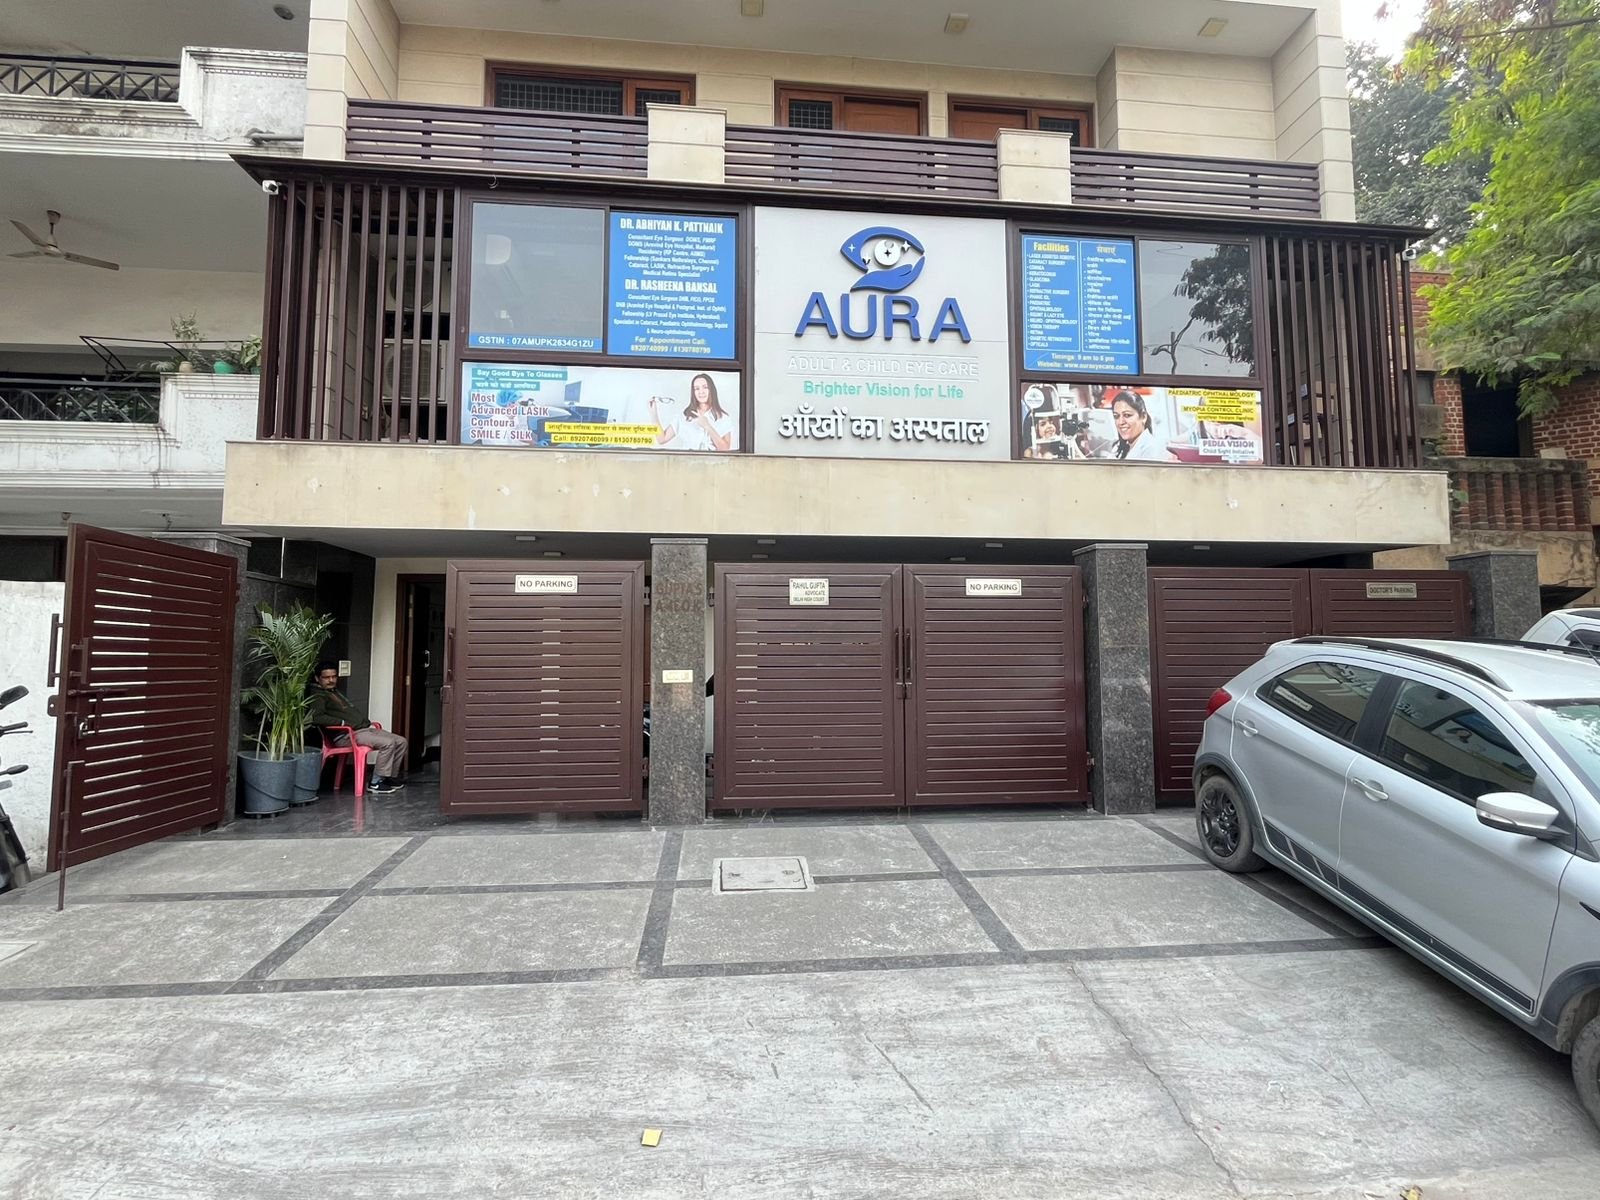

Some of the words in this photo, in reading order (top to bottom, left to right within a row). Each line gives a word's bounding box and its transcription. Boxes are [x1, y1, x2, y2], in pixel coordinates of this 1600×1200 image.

[620, 218, 634, 229] DR.
[674, 220, 682, 231] K.
[684, 221, 723, 234] PATTNAIK
[1034, 242, 1070, 253] Facilities
[625, 279, 639, 290] DR.
[685, 281, 718, 293] BANSAL
[795, 292, 971, 343] AURA
[478, 336, 504, 344] GSTIN
[788, 356, 837, 371] ADULT
[841, 359, 851, 372] &
[856, 359, 900, 373] CHILD
[905, 361, 936, 375] EYE
[938, 362, 979, 376] CARE
[803, 380, 862, 398] Brighter
[866, 382, 910, 397] Vision
[914, 384, 934, 398] for
[938, 384, 964, 398] Life
[471, 393, 495, 402] Most
[471, 405, 518, 415] Advanced
[521, 407, 549, 416] LASIK
[471, 418, 515, 427] Contoura
[471, 430, 501, 439] SMILE
[510, 431, 532, 440] SILK
[850, 414, 884, 440] का
[889, 416, 990, 445] अस्पताल
